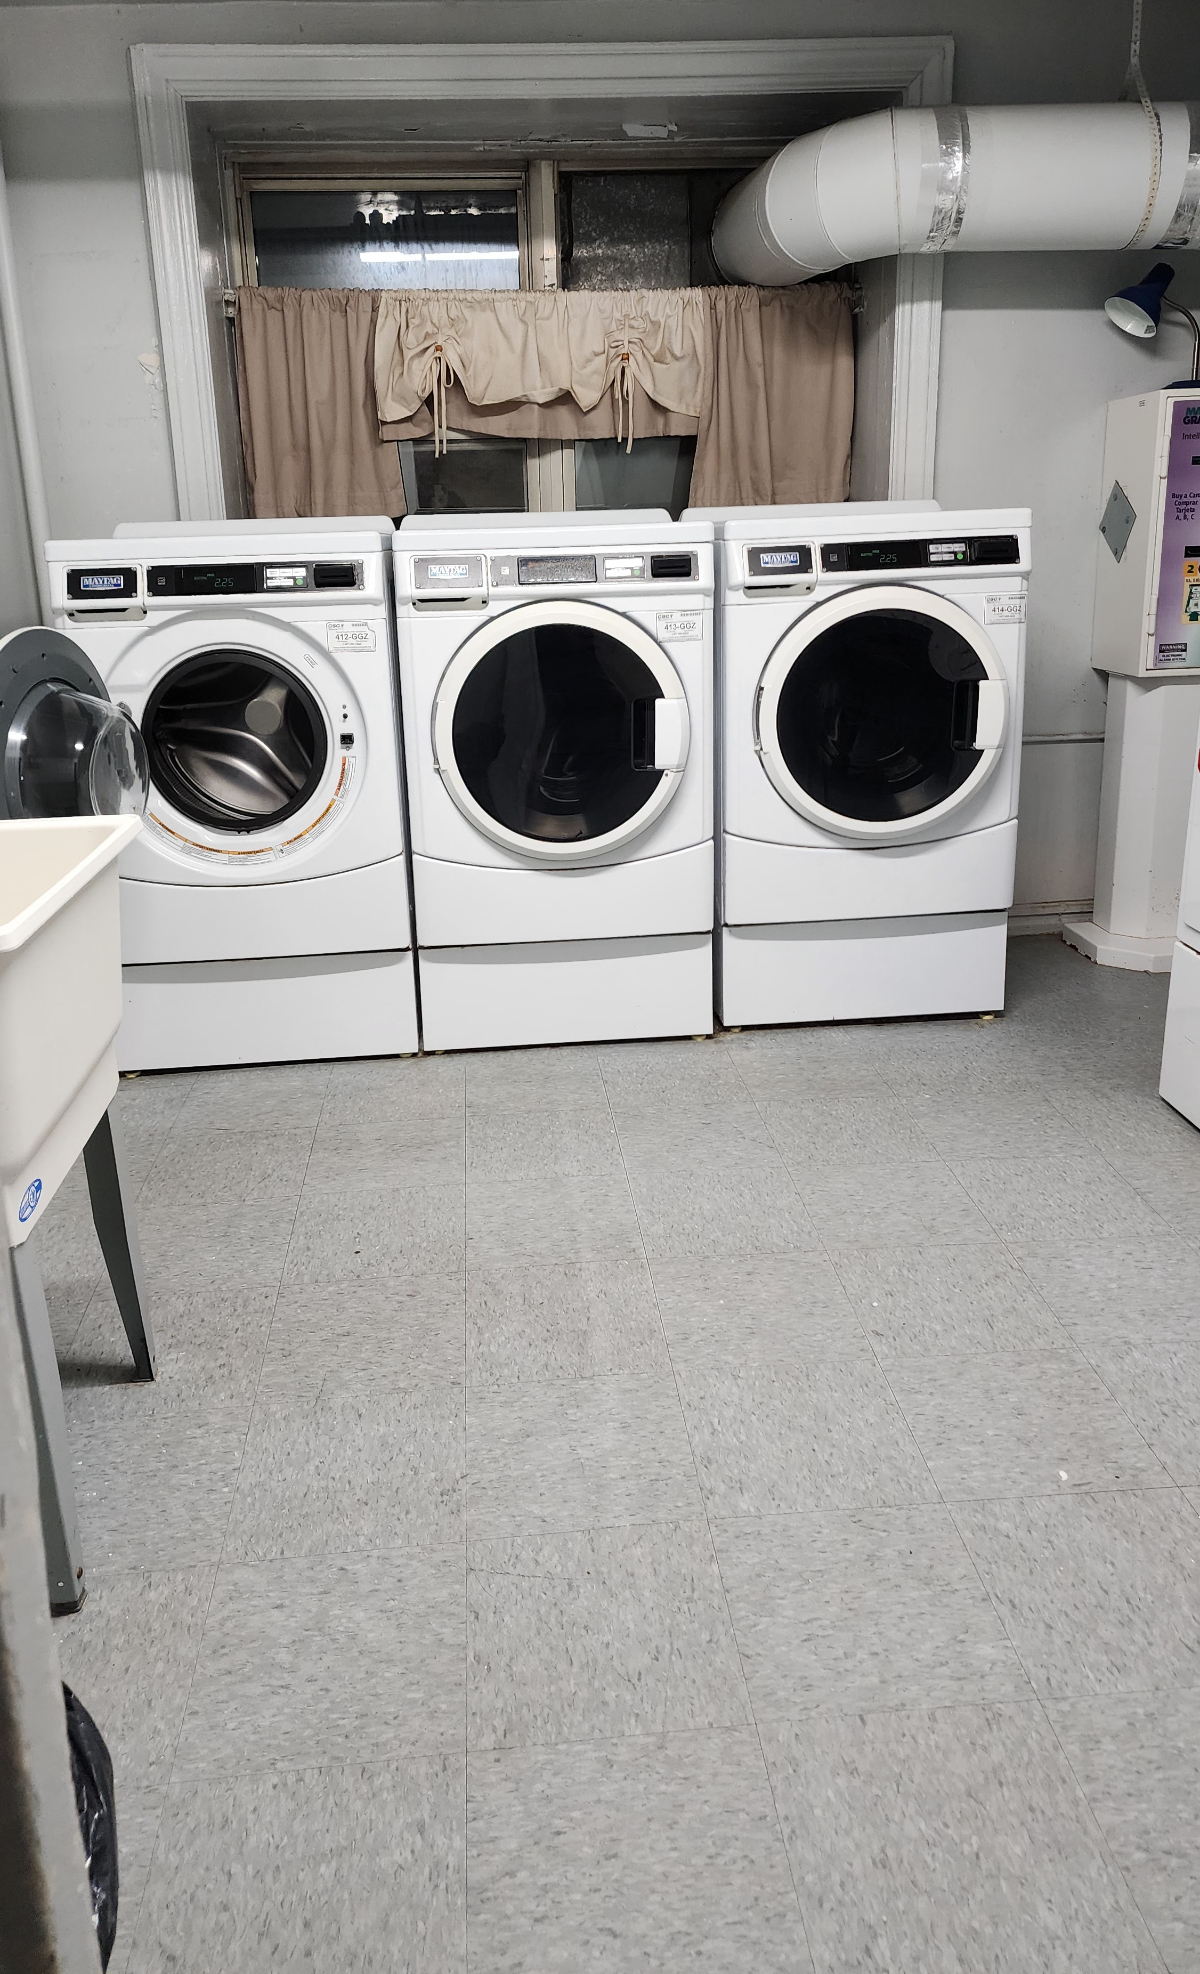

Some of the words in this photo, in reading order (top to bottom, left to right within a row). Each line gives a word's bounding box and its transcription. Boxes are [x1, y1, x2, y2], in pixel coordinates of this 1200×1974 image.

[1171, 492, 1183, 500] Buy
[1176, 507, 1195, 515] Tarjeta
[429, 566, 467, 576] MAYTAG
[1187, 564, 1195, 574] 2
[83, 576, 121, 586] MAYTAG
[214, 577, 234, 588] 2.25
[992, 605, 1022, 613] 414-GGZ
[664, 622, 697, 631] 413-GGZ
[335, 633, 369, 641] 412-GGZ
